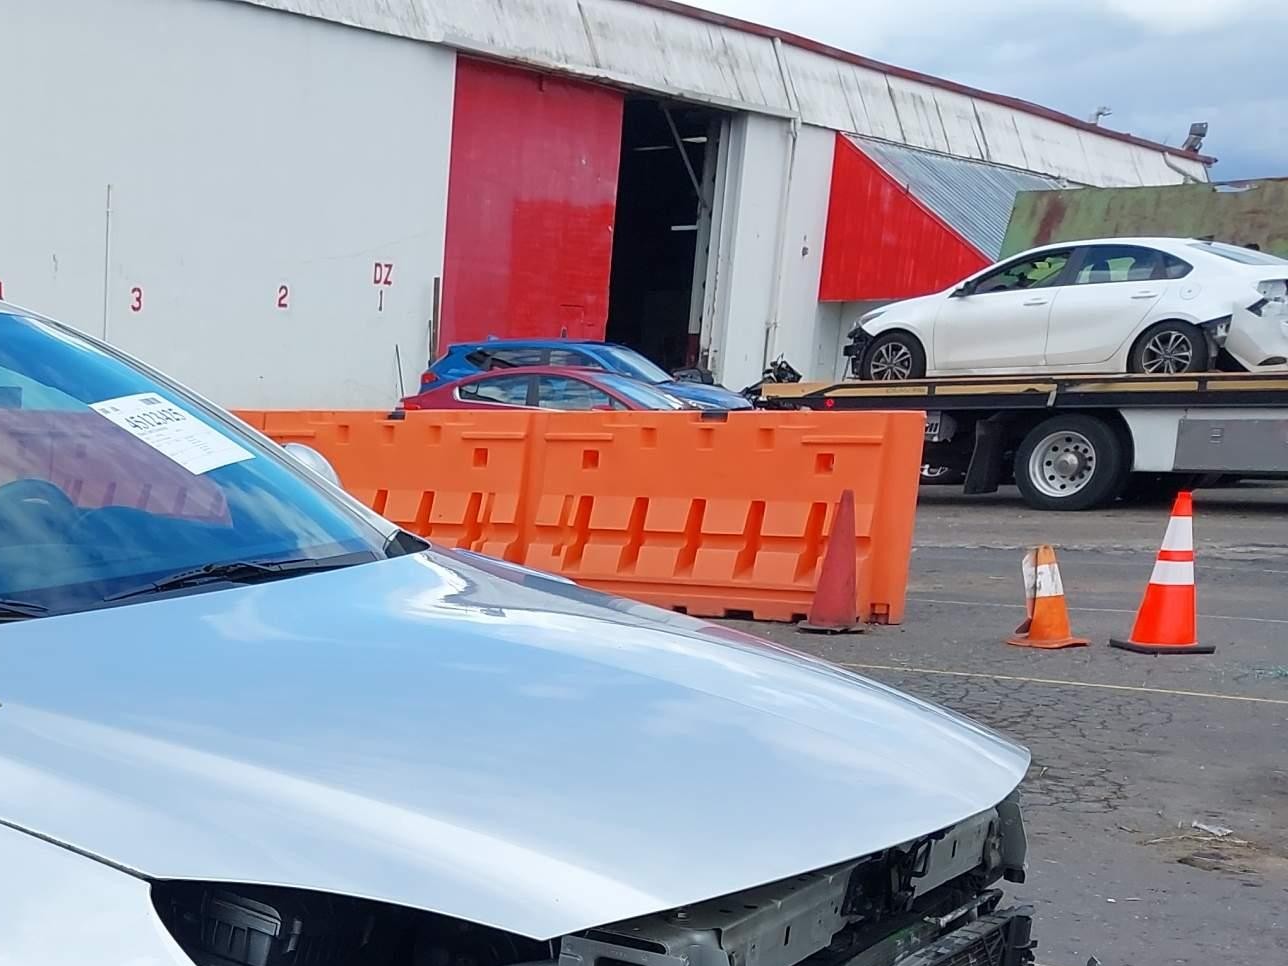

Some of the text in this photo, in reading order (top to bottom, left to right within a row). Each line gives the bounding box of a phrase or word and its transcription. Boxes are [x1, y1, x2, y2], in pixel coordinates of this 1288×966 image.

[373, 262, 393, 286] DZ
[131, 287, 142, 312] 3
[278, 285, 288, 308] 2
[378, 289, 383, 312] 1
